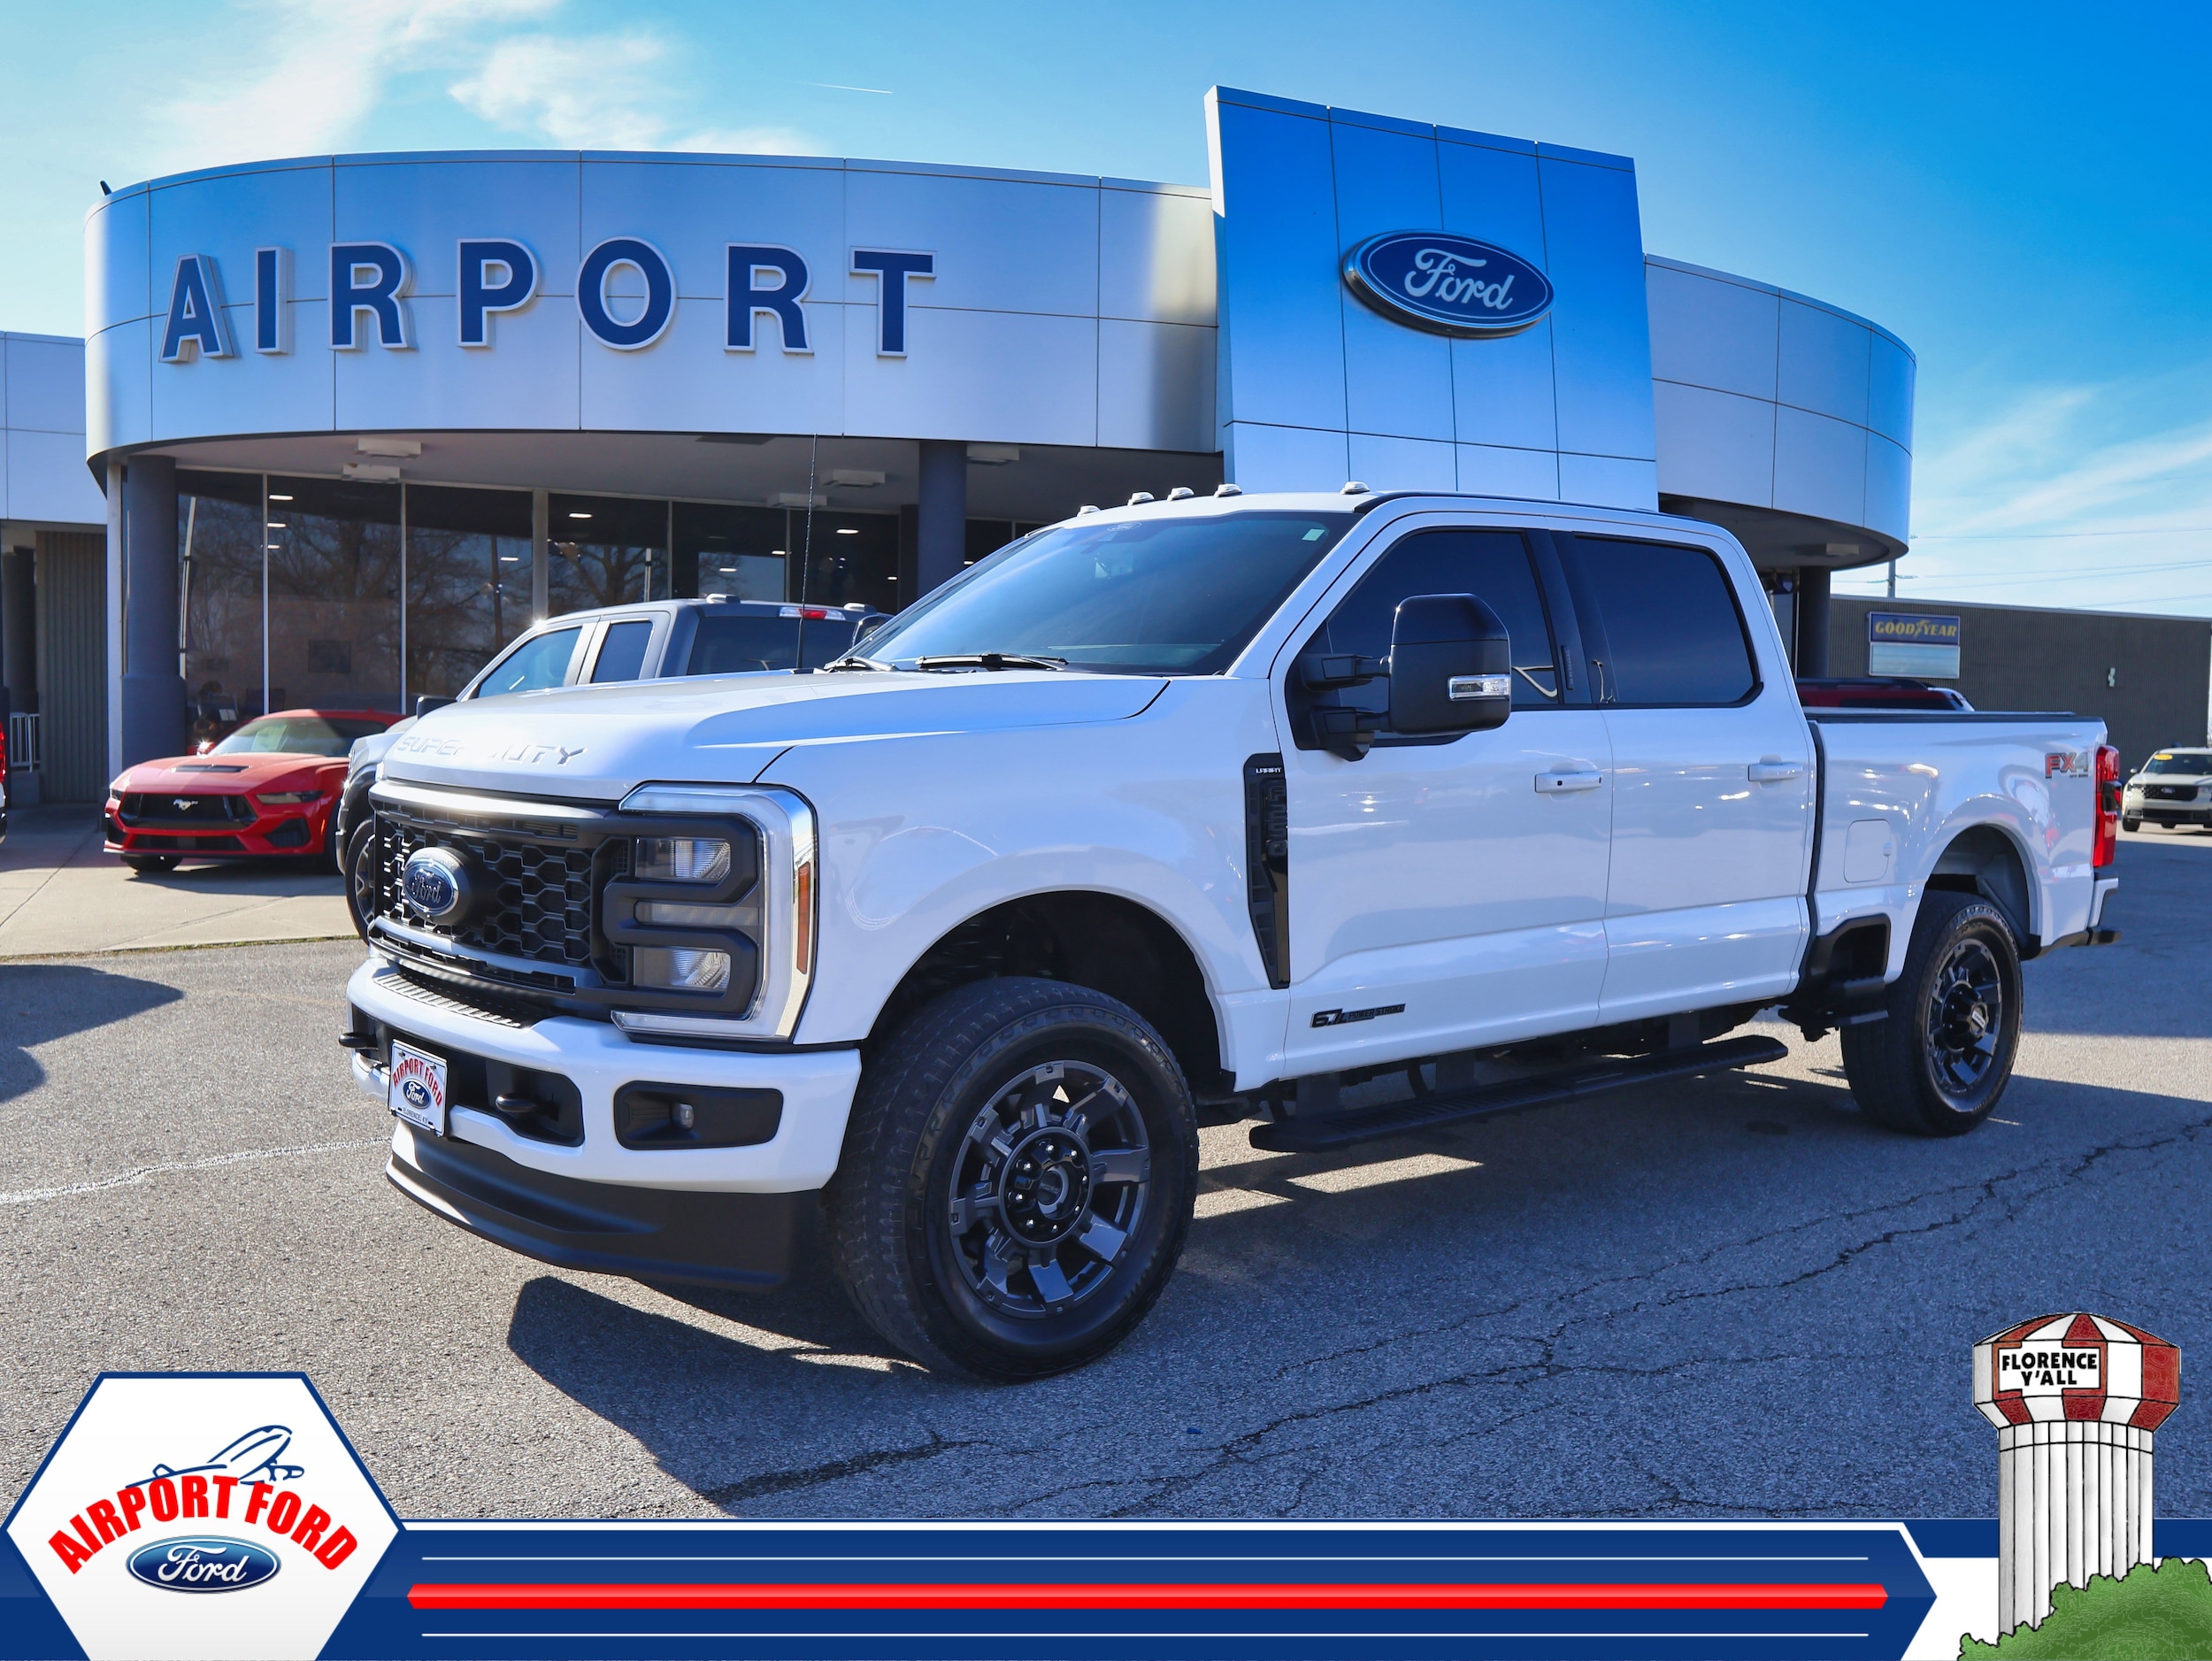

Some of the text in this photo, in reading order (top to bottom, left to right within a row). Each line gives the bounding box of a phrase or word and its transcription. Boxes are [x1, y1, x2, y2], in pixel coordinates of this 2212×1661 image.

[1404, 248, 1516, 311] Ford
[158, 235, 937, 362] AIRPORT
[1874, 619, 1958, 638] GOODYEAR
[483, 743, 588, 766] UTY
[2045, 752, 2089, 779] FX4
[411, 868, 444, 904] Ford
[1348, 1010, 1375, 1020] POWER
[1376, 1004, 1405, 1017] STROKE
[393, 1058, 442, 1106] AIRPORT FORD
[406, 1081, 425, 1104] Ford
